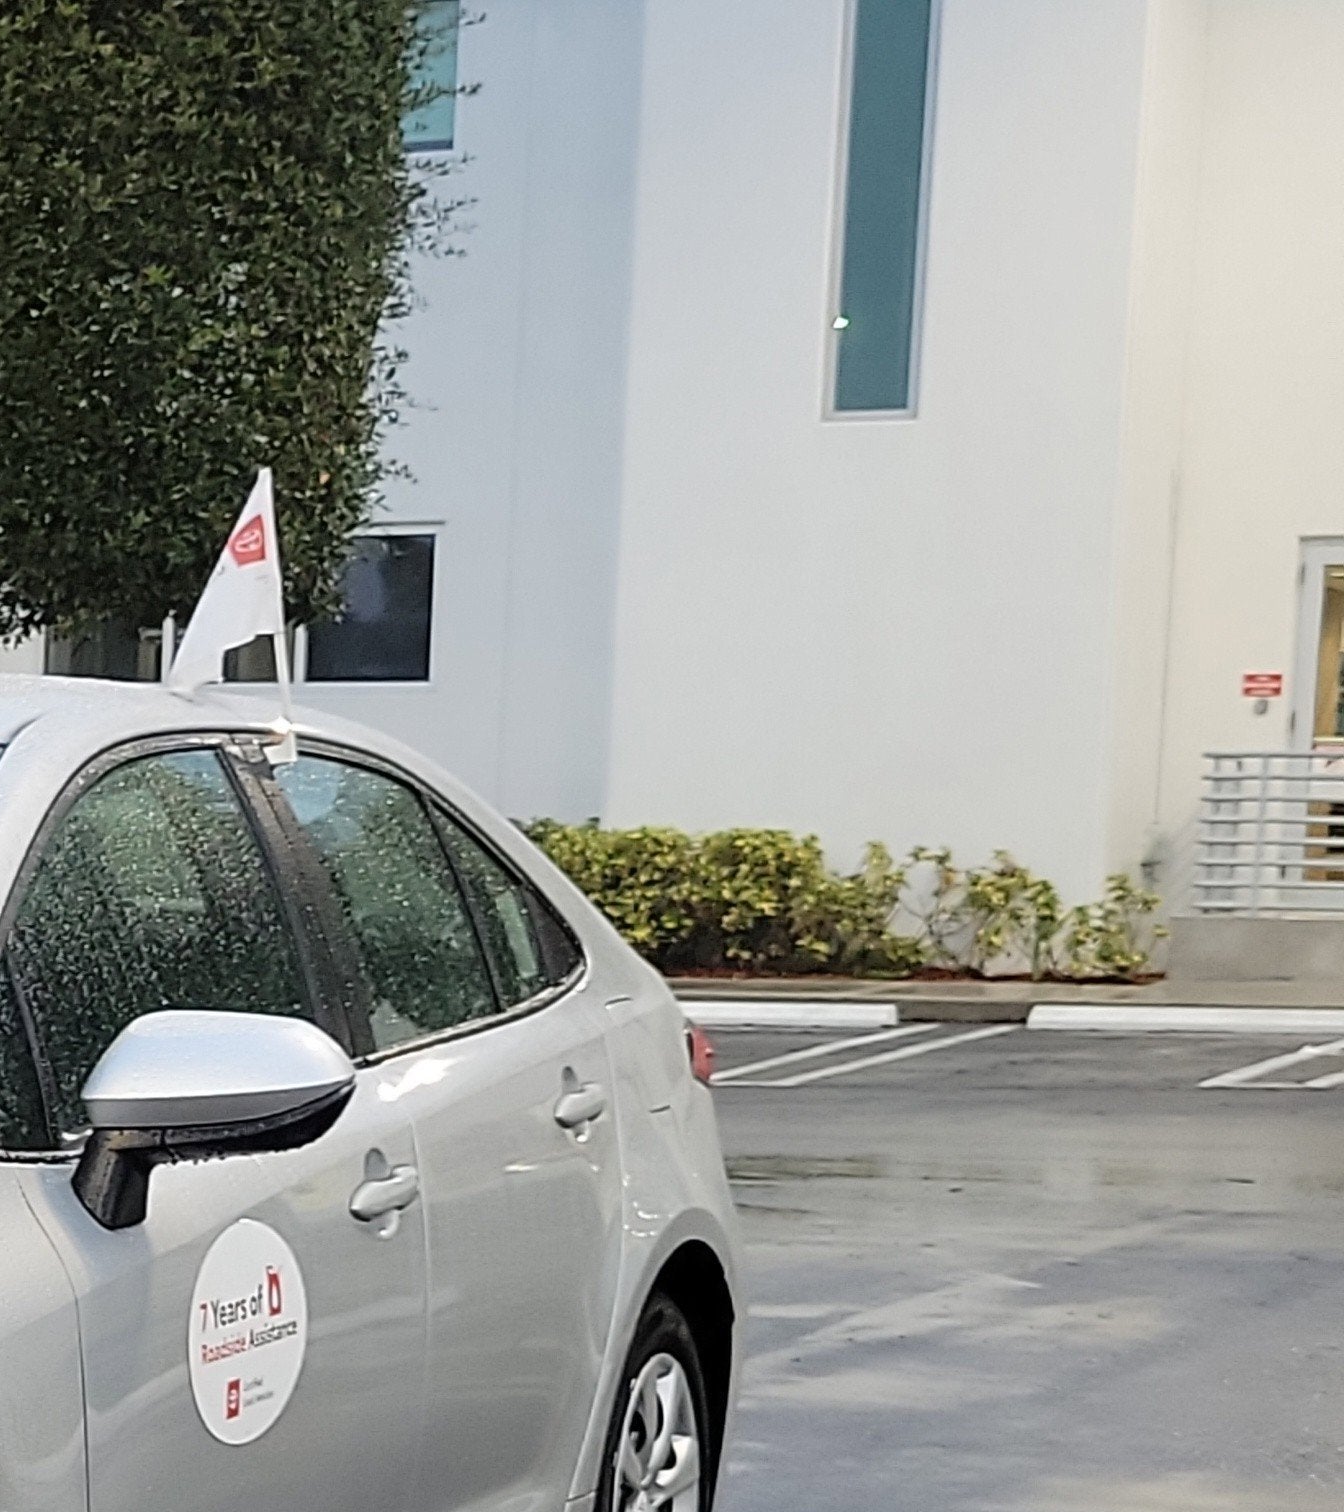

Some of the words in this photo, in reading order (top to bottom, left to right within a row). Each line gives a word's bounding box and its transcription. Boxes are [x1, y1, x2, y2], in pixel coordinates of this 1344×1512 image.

[200, 1303, 208, 1331] 7
[211, 1298, 247, 1329] Years
[249, 1284, 263, 1316] of
[248, 1321, 297, 1348] Assistance
